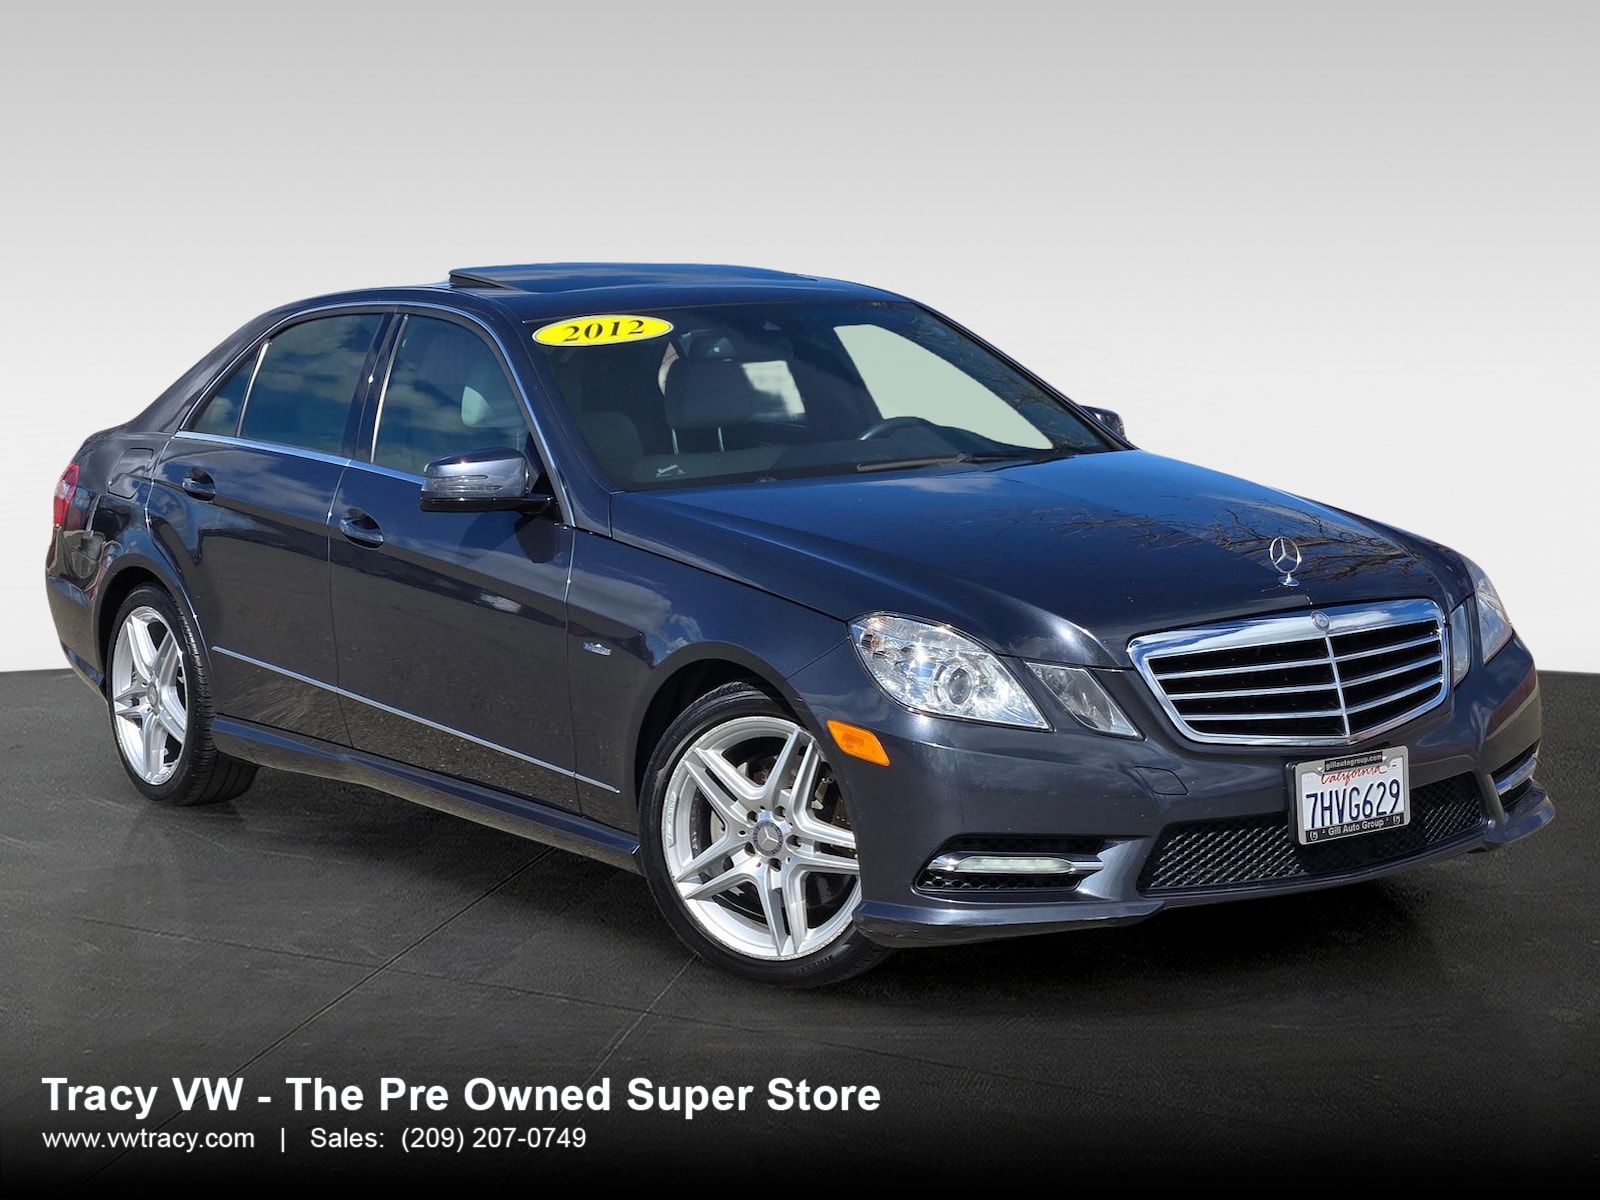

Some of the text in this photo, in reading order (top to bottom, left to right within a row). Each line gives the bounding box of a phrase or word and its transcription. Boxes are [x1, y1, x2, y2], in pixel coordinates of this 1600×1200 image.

[563, 319, 645, 342] 2012
[1305, 778, 1400, 829] 7HVG629
[1328, 827, 1341, 836] Gill
[1342, 823, 1360, 834] Auto
[1361, 819, 1385, 831] Group
